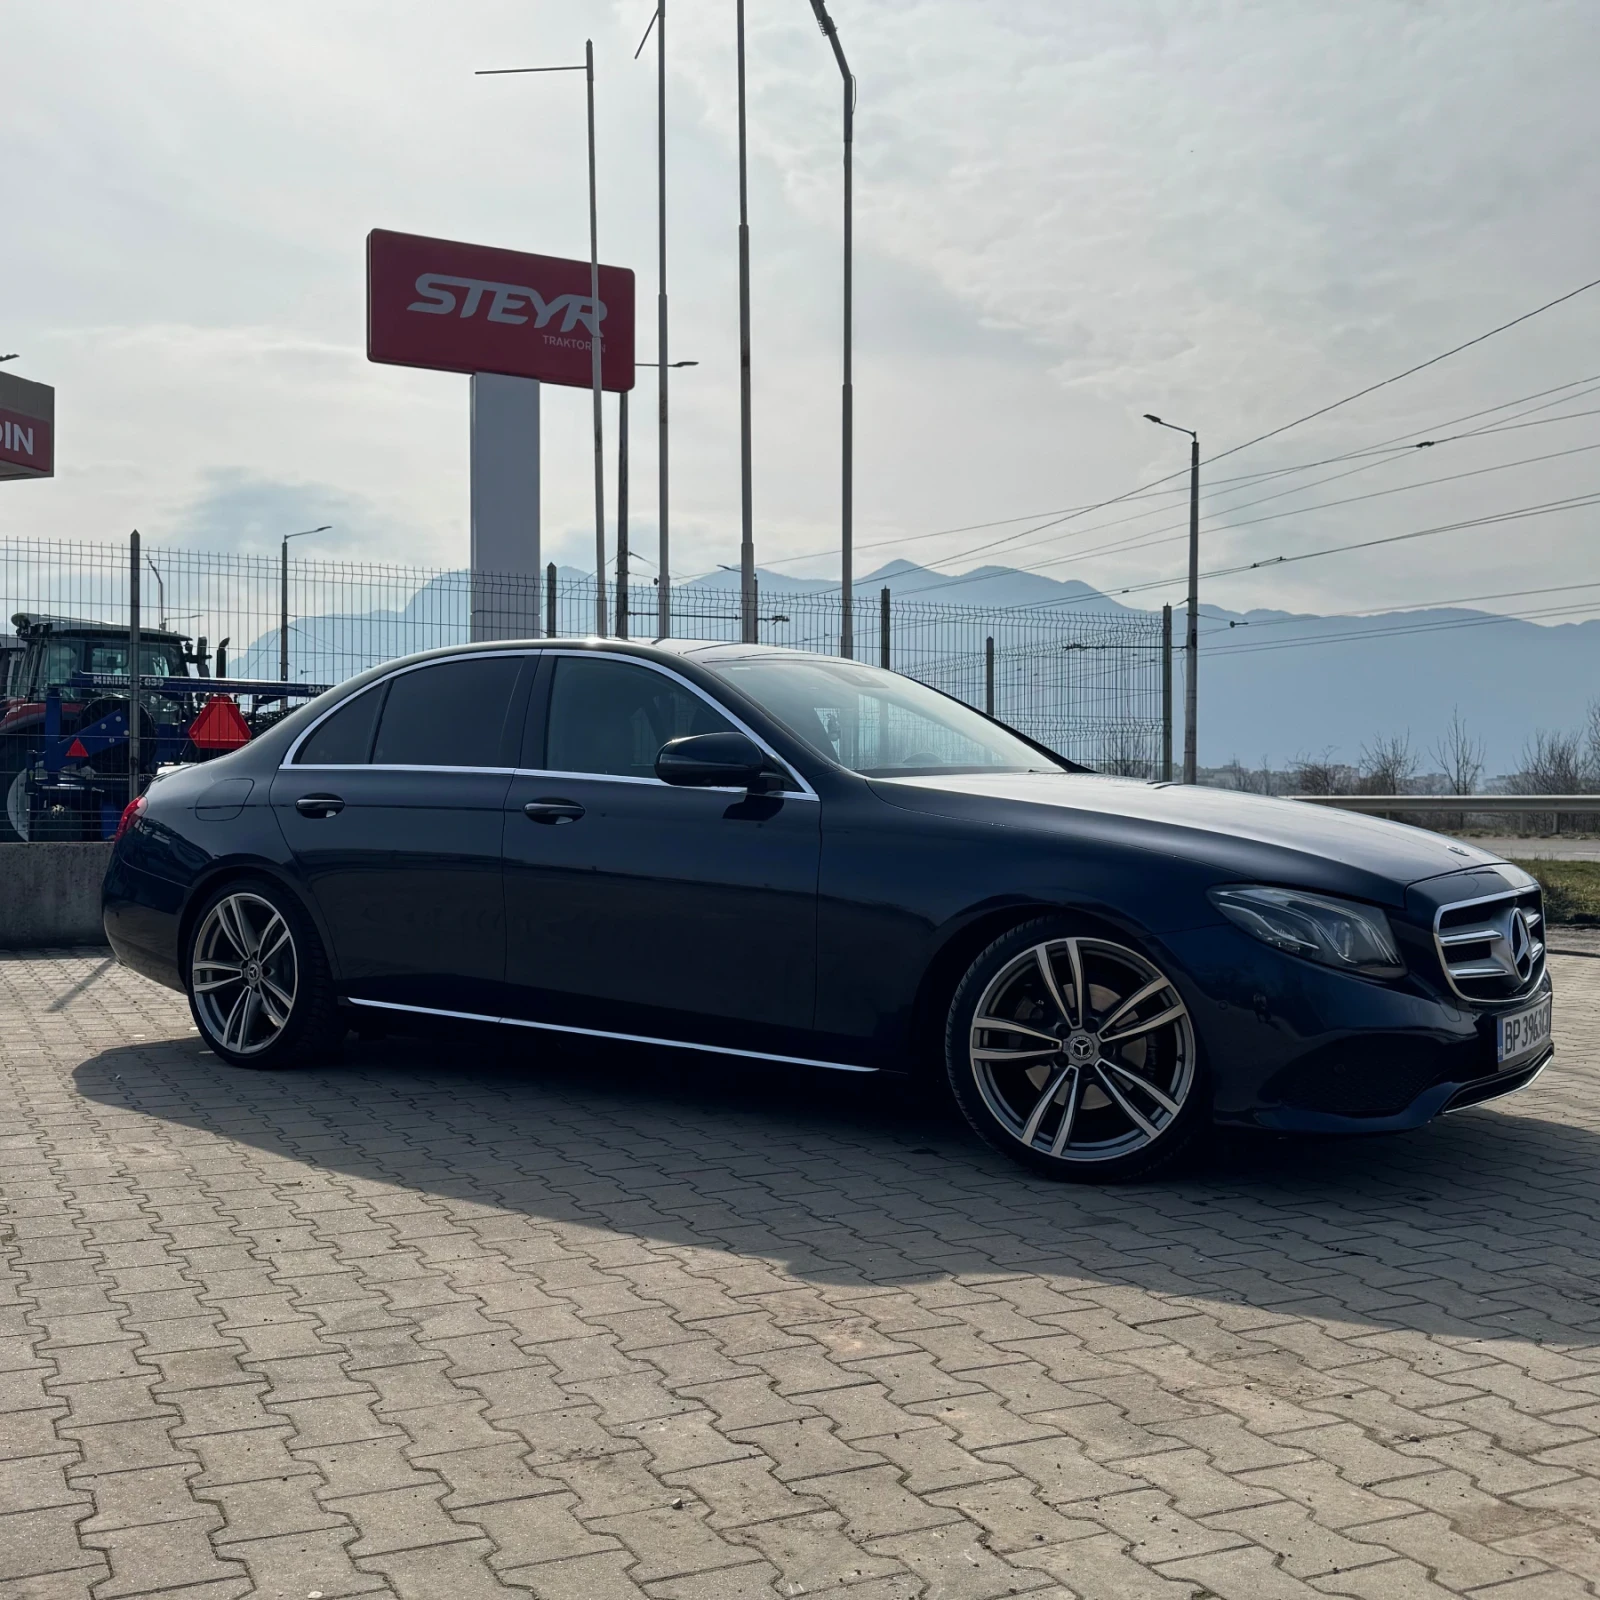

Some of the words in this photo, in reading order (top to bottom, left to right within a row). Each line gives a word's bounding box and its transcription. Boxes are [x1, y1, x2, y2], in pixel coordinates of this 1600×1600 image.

[406, 273, 608, 337] STEYR
[542, 334, 606, 353] TRAKTORN
[1505, 1019, 1520, 1055] BP
